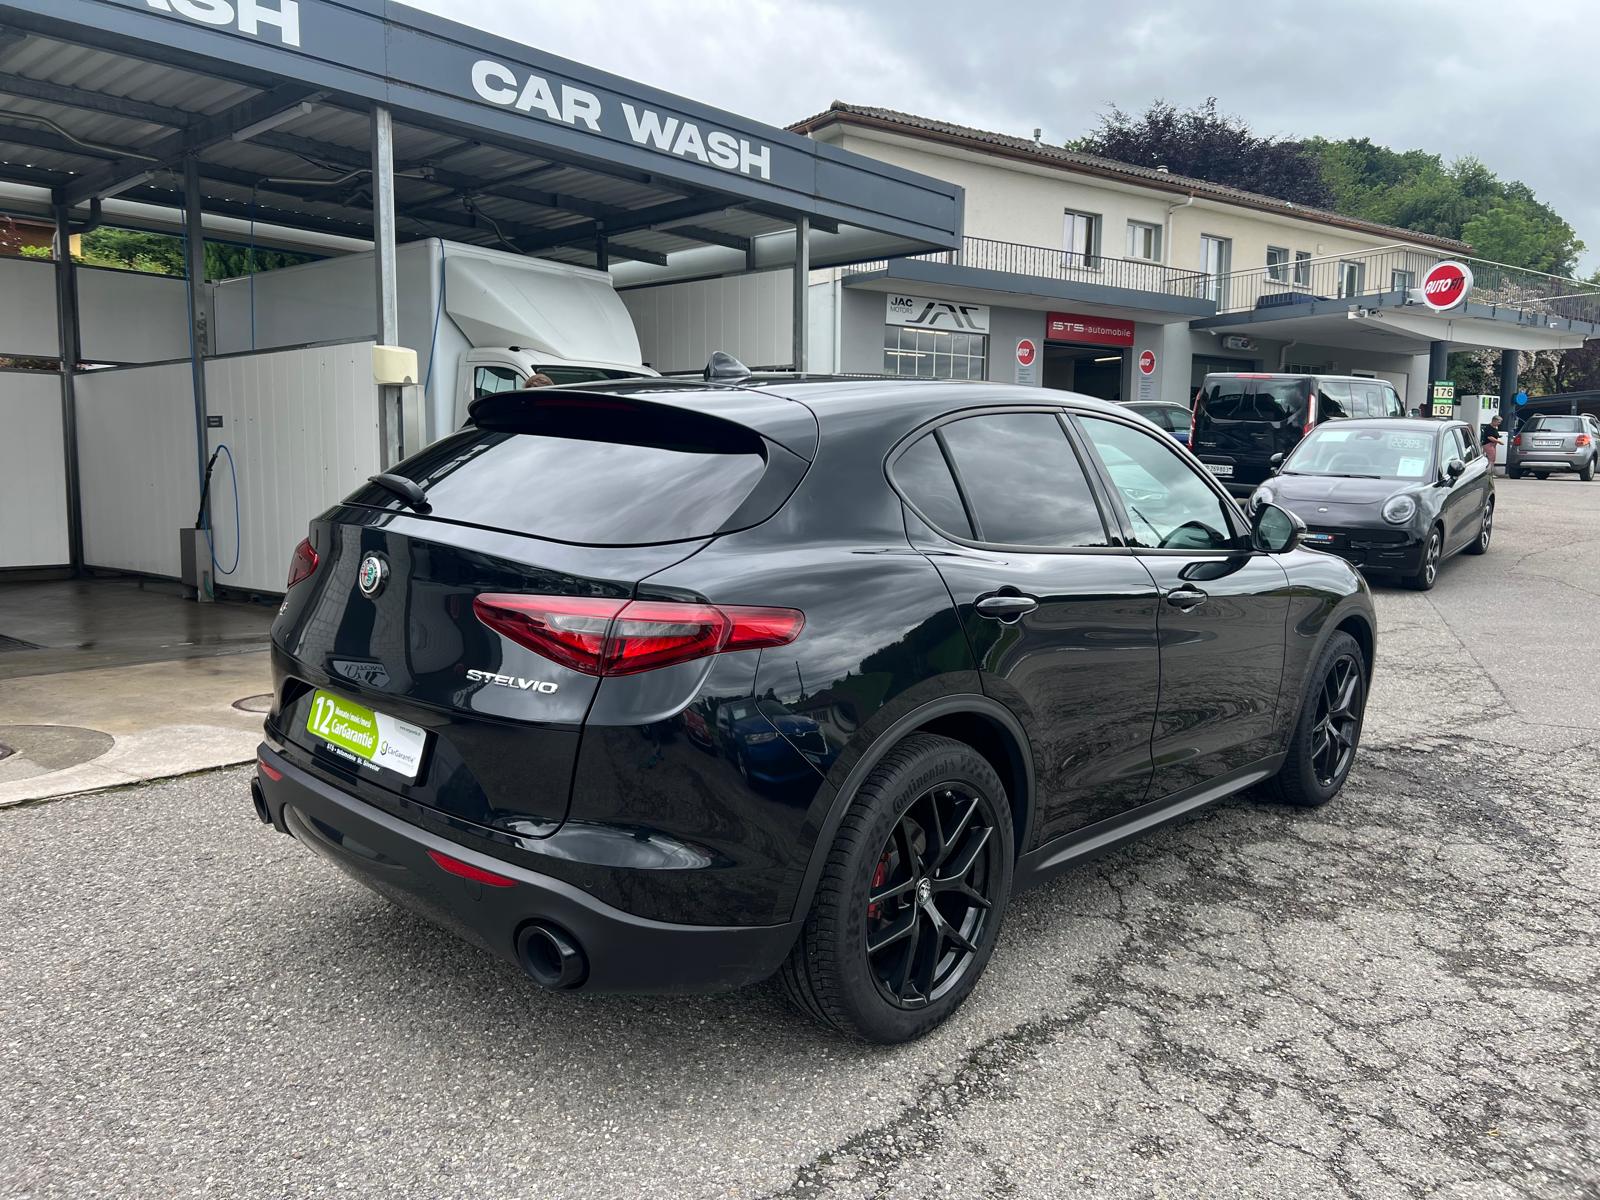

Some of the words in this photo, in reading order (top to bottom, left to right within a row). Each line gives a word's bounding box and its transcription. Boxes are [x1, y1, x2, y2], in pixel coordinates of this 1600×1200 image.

[148, 0, 300, 47] SH
[471, 60, 602, 132] CAR
[621, 102, 770, 180] WASH
[890, 305, 913, 314] MOTORS
[891, 297, 913, 307] JAC
[1434, 388, 1453, 397] 176
[1433, 405, 1452, 415] 187
[466, 669, 559, 694] STELVIO
[313, 696, 335, 735] 12
[893, 759, 949, 815] Continental
